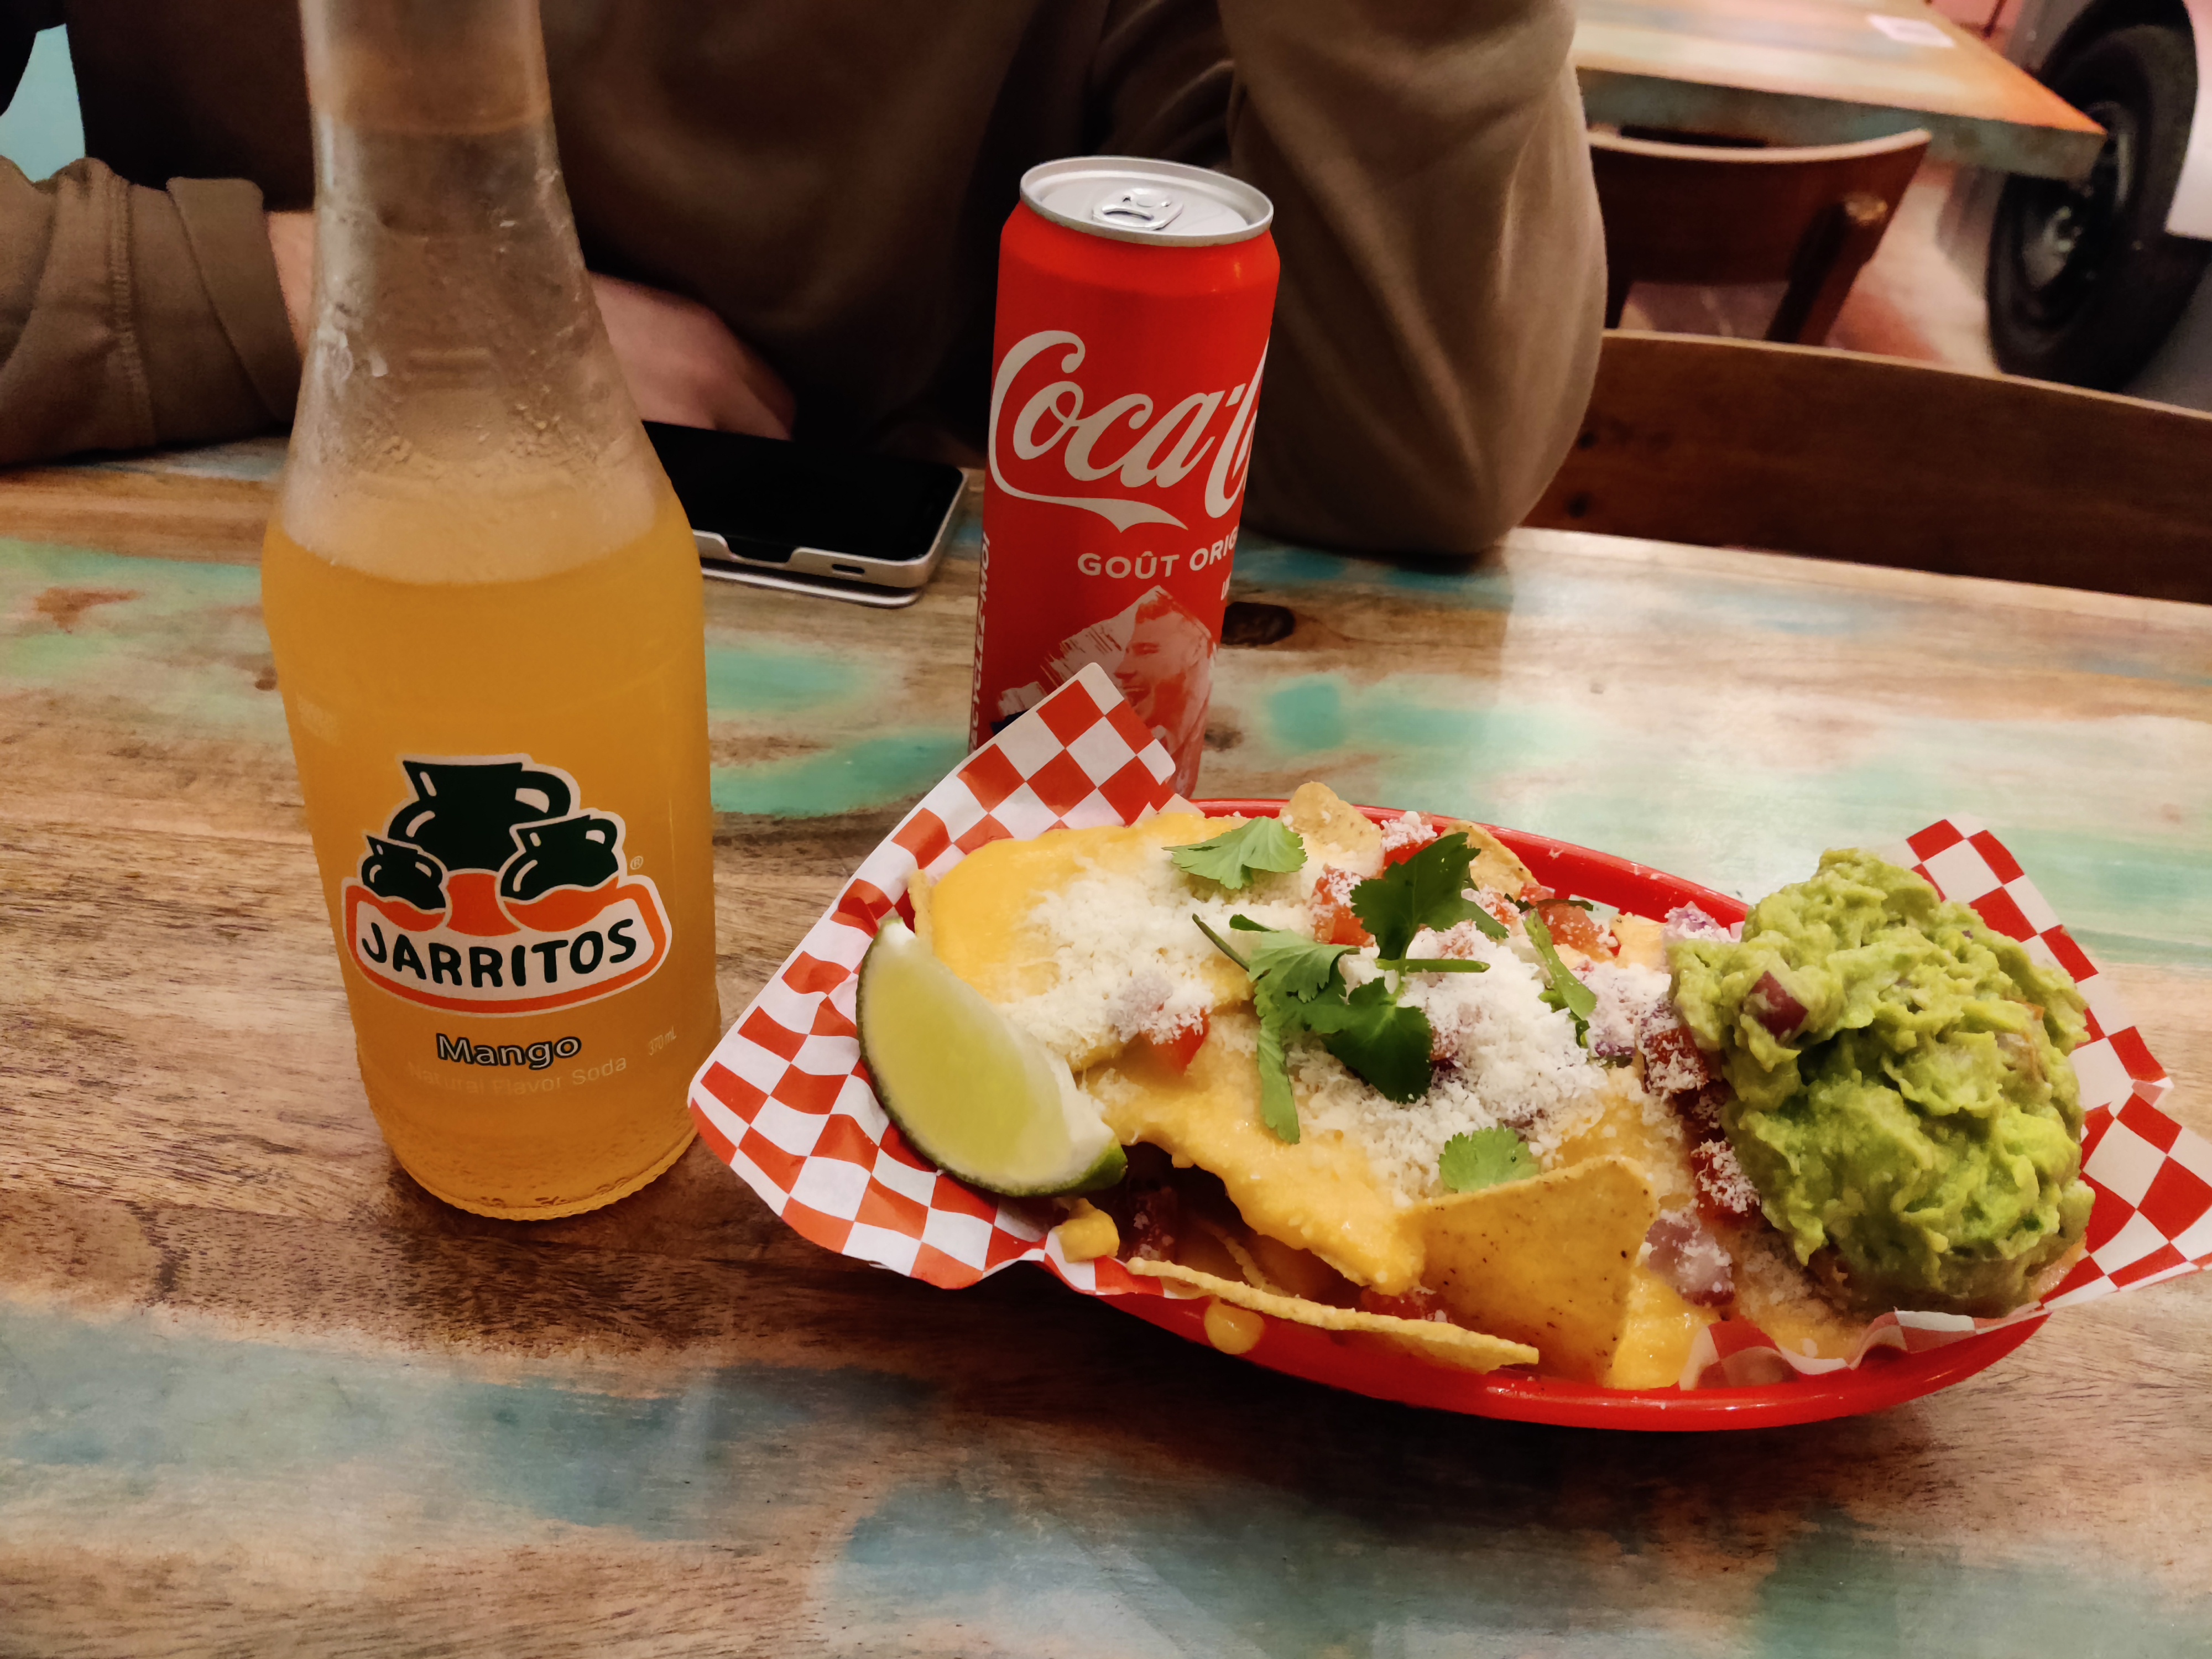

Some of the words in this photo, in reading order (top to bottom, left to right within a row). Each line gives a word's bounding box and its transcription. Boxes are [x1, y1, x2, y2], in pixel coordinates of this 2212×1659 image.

[1077, 551, 1180, 580] GOÛT
[361, 918, 637, 988] JARRITOS
[436, 1032, 582, 1071] Mango
[408, 1060, 484, 1095] Natural
[492, 1075, 563, 1095] Flavor
[572, 1056, 628, 1086] Soda
